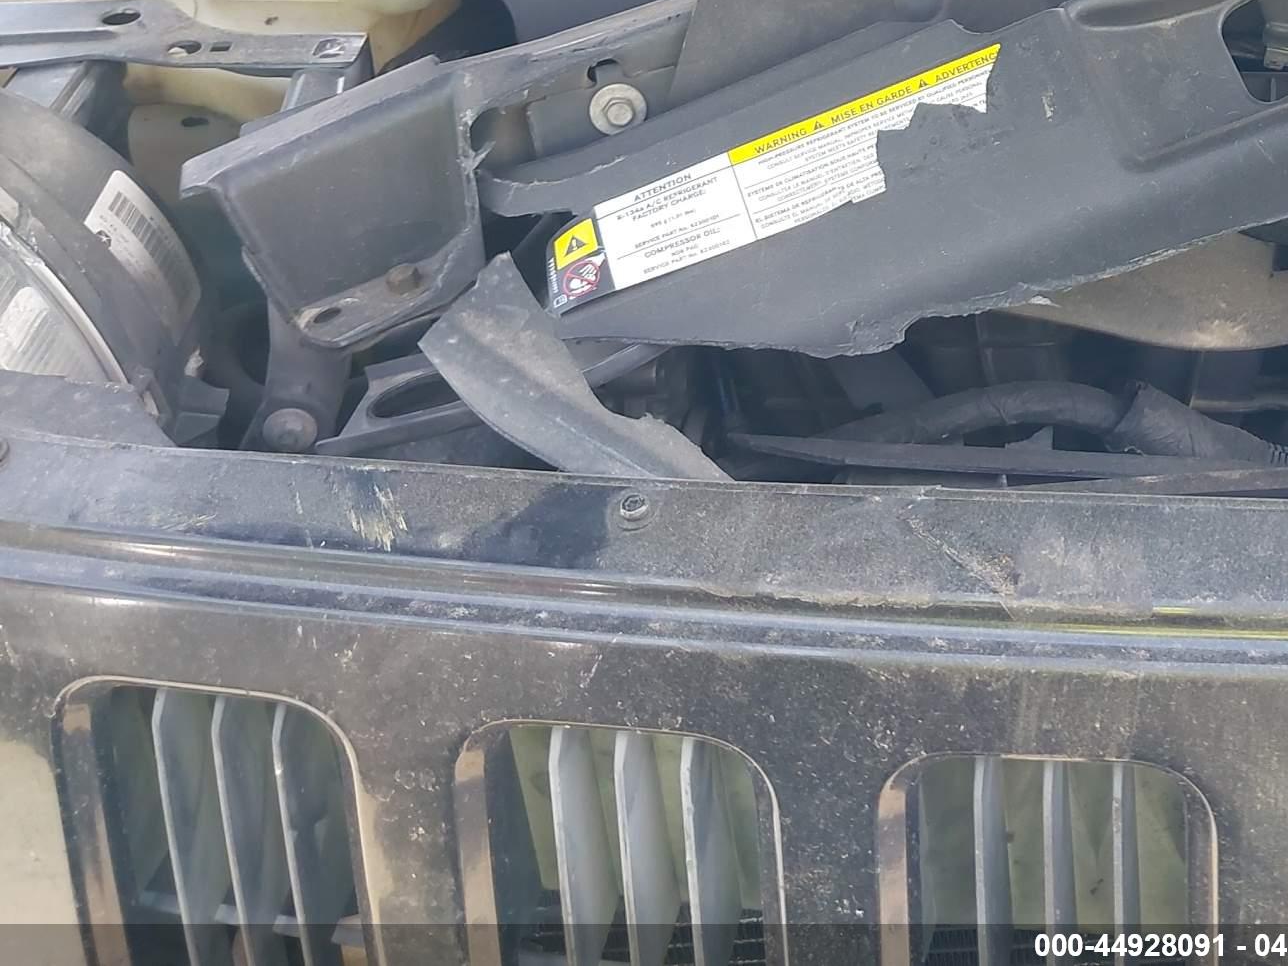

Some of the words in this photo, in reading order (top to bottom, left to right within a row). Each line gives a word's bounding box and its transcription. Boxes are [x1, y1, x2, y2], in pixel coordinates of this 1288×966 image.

[754, 128, 807, 154] WARNING
[831, 108, 859, 124] MISE
[860, 102, 874, 112] EN
[876, 86, 913, 106] GARDE
[934, 51, 999, 82] ADVERTENC
[632, 173, 692, 202] ATTENTION
[646, 200, 662, 209] A/C
[664, 177, 718, 203] REFRIGERANT
[632, 203, 669, 222] FACTORY
[644, 233, 702, 259] COMPRESSOR
